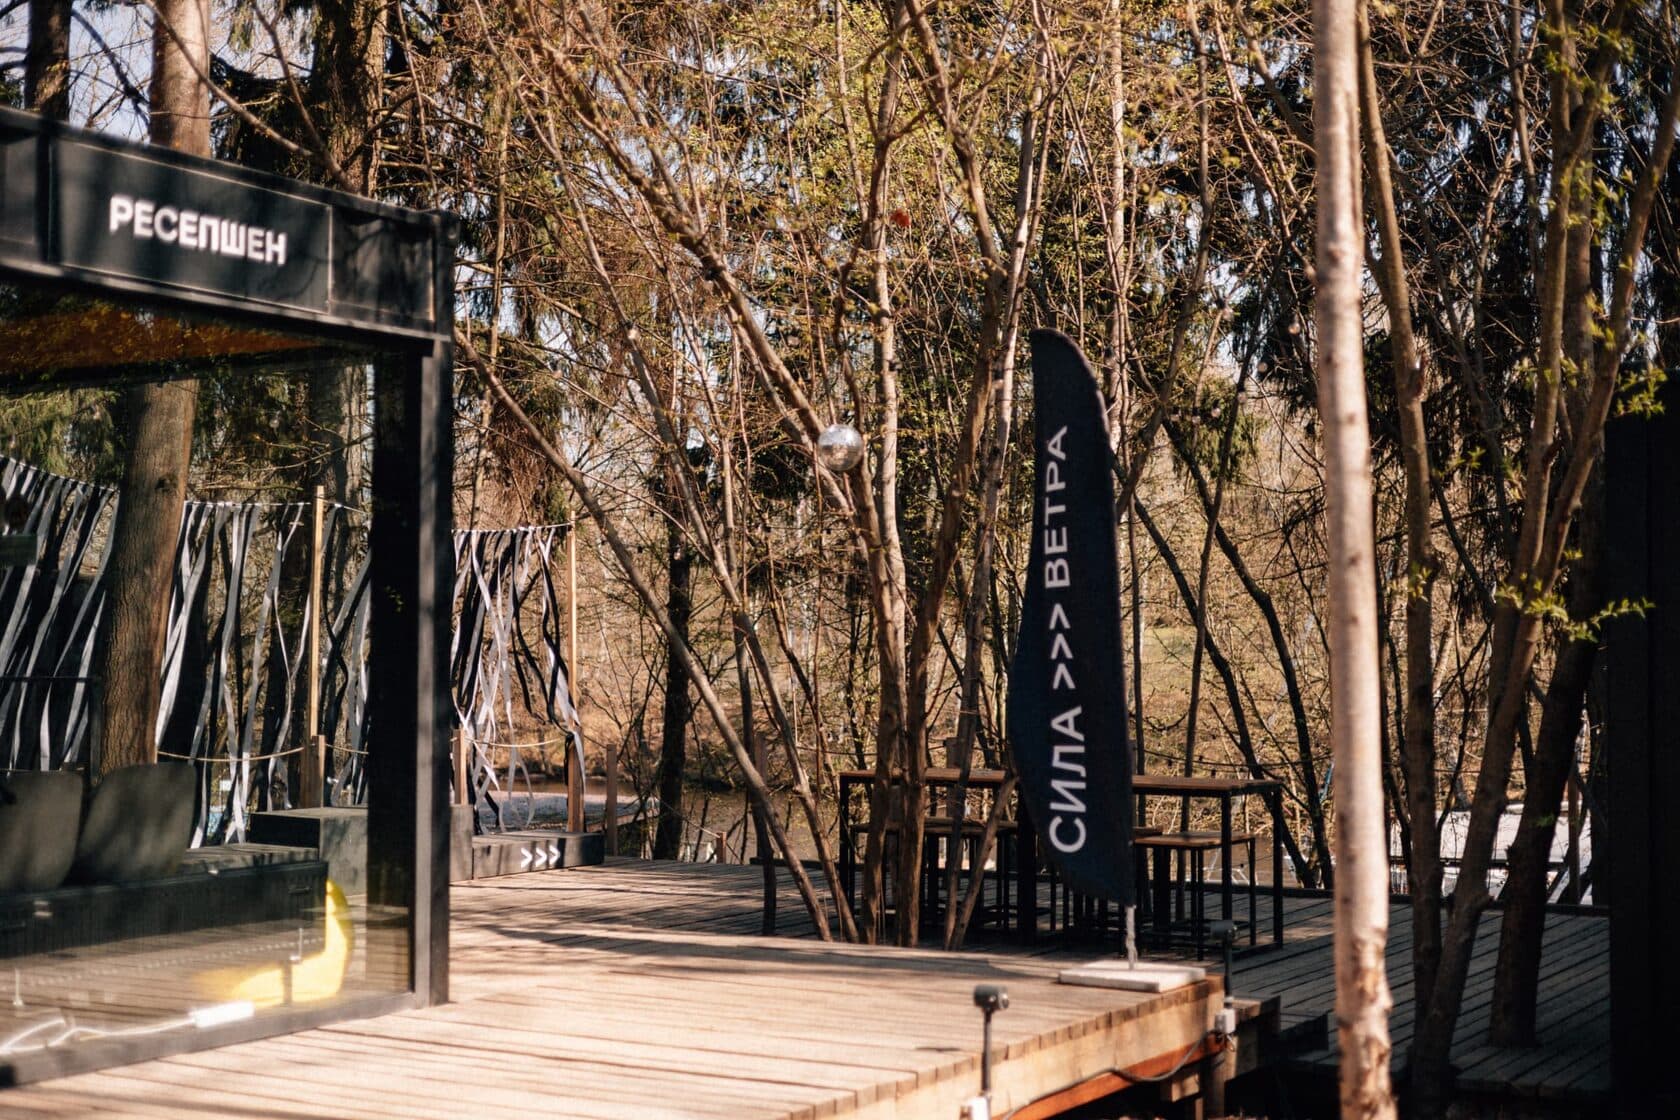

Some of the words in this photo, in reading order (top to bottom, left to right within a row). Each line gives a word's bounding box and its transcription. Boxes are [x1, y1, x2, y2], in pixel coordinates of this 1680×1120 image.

[109, 194, 288, 266] РЕСЕПШЕН
[1044, 425, 1071, 589] ВЕТРА
[1049, 705, 1087, 853] СИЛА
